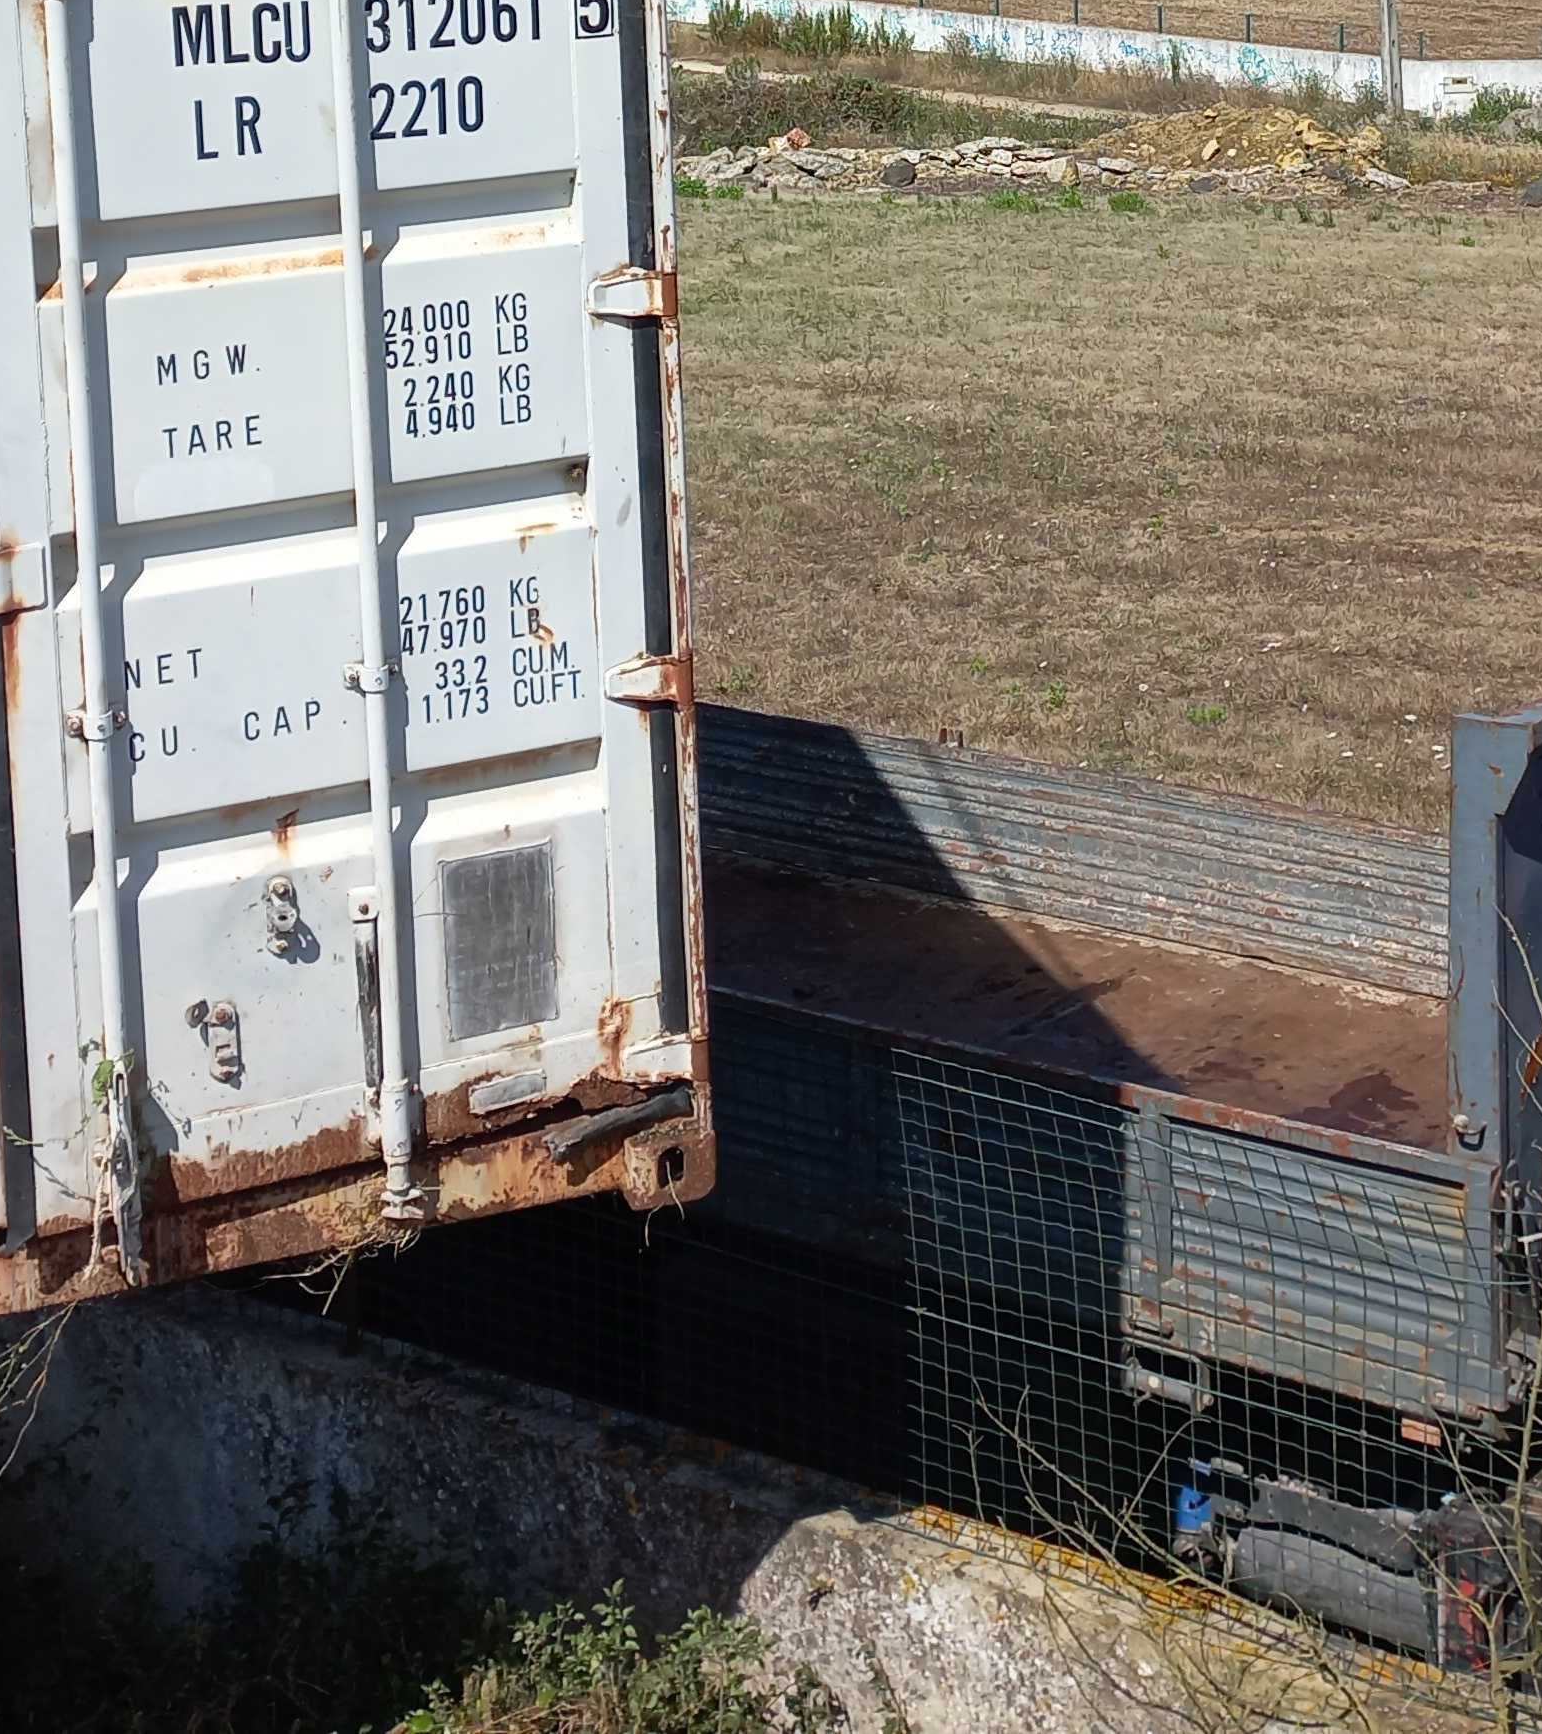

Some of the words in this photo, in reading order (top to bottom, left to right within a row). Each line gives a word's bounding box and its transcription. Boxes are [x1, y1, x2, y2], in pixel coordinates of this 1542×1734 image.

[171, 0, 312, 68] MLCU
[367, 75, 484, 141] 2210
[382, 299, 470, 339] 24.000
[494, 292, 528, 325] KG
[384, 330, 472, 369] 52.910
[496, 323, 529, 355] LB
[403, 370, 474, 408] 2.240
[498, 362, 531, 395] KG
[161, 414, 263, 459] TARE
[405, 401, 475, 439] 4.940
[500, 394, 532, 426] LB
[399, 584, 486, 626] 21.760
[508, 575, 540, 608] KG
[401, 615, 487, 656] 47.970
[510, 607, 541, 639] LB
[123, 648, 203, 691] NET
[434, 654, 488, 691] 33.2
[511, 640, 576, 677] CU.M.
[421, 685, 490, 724] 1.173
[512, 668, 586, 708] CU.FT.
[128, 725, 197, 763] CU.
